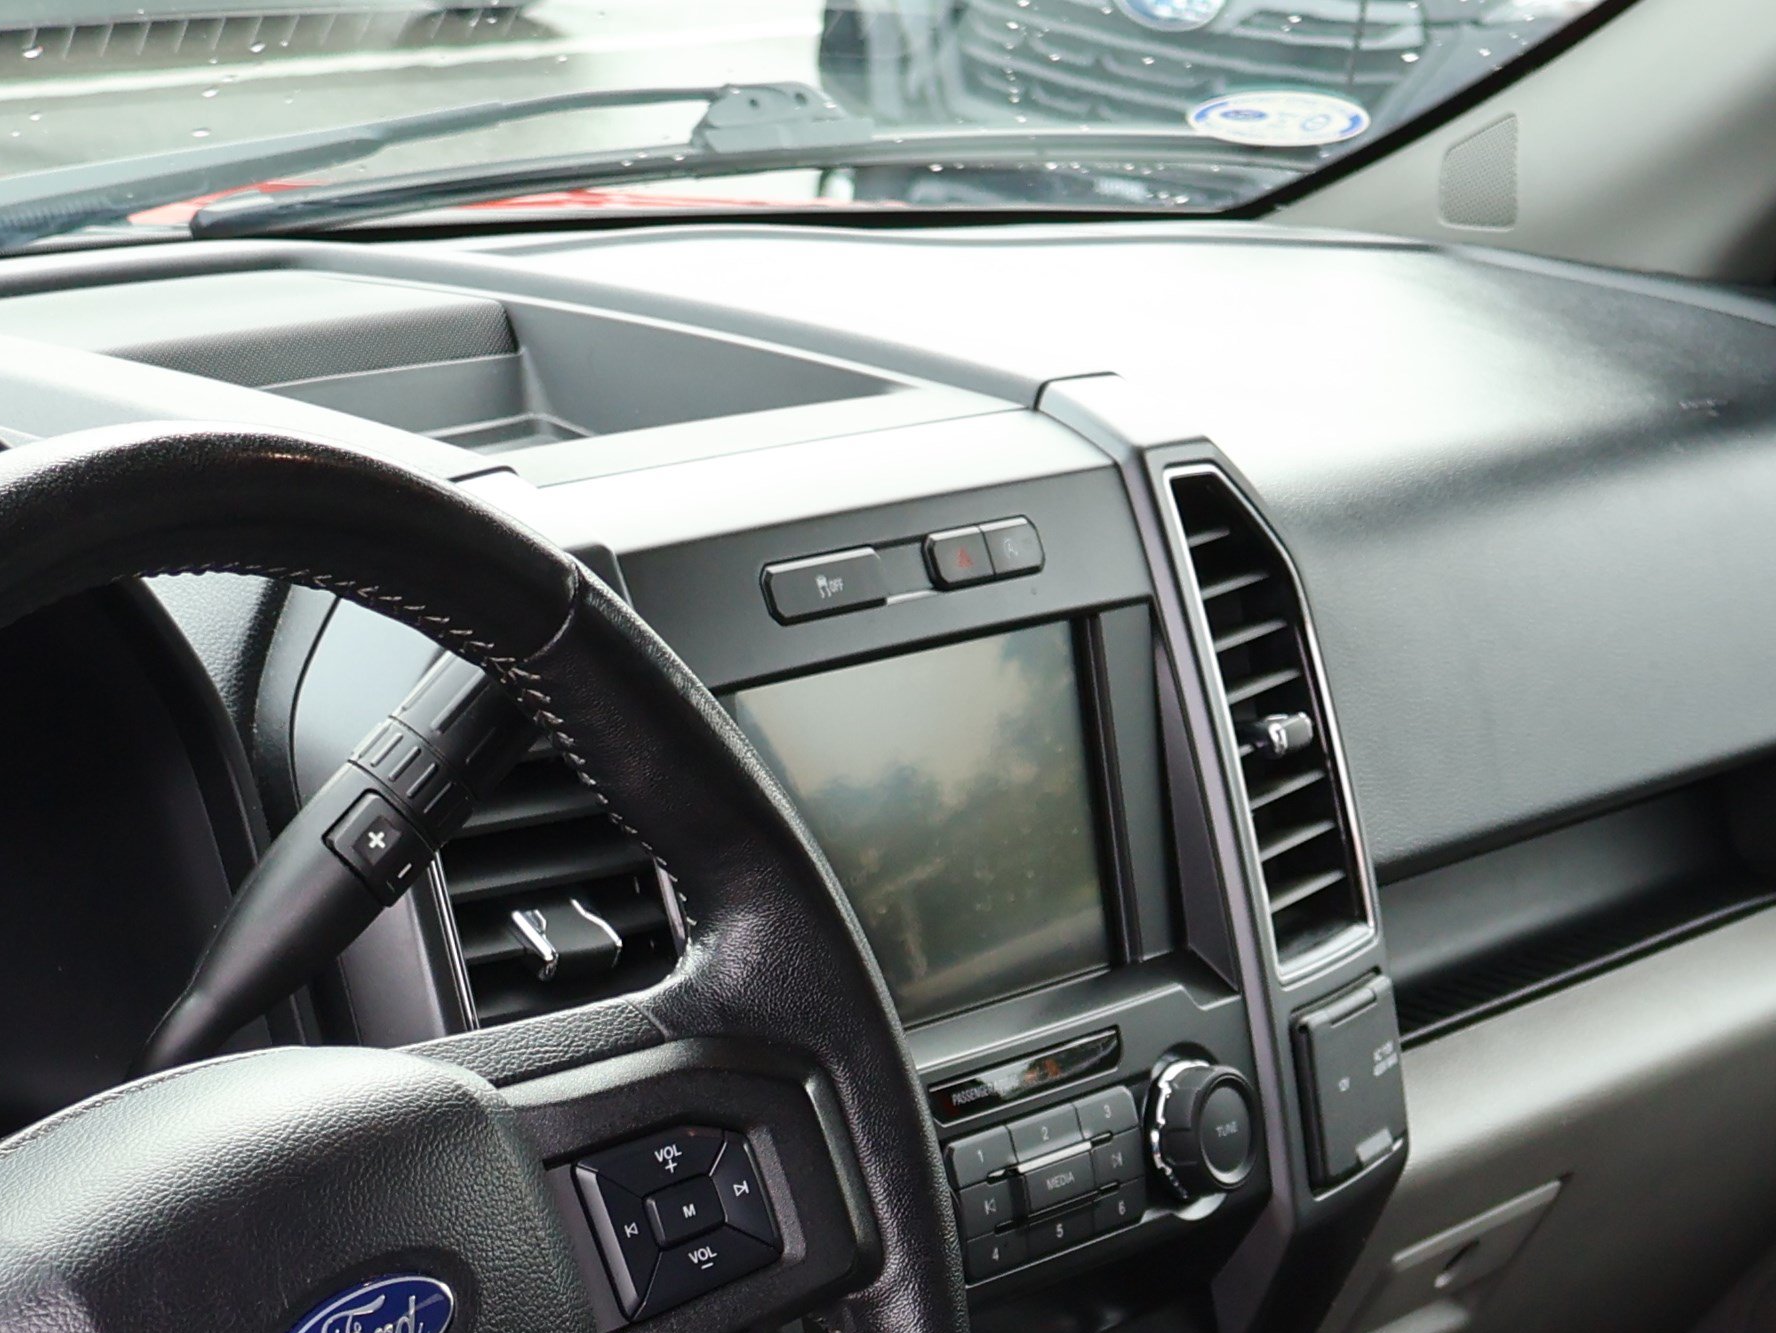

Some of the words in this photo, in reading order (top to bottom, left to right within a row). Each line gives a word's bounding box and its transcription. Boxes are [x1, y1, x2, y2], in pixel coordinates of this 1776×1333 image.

[1103, 1105, 1111, 1119] 3
[1041, 1126, 1050, 1141] 2
[654, 1144, 682, 1163] VOL
[1046, 1170, 1074, 1190] MEDIA
[682, 1203, 697, 1219] M
[1055, 1223, 1064, 1238] 5
[688, 1246, 718, 1264] VOL
[991, 1247, 999, 1261] 4
